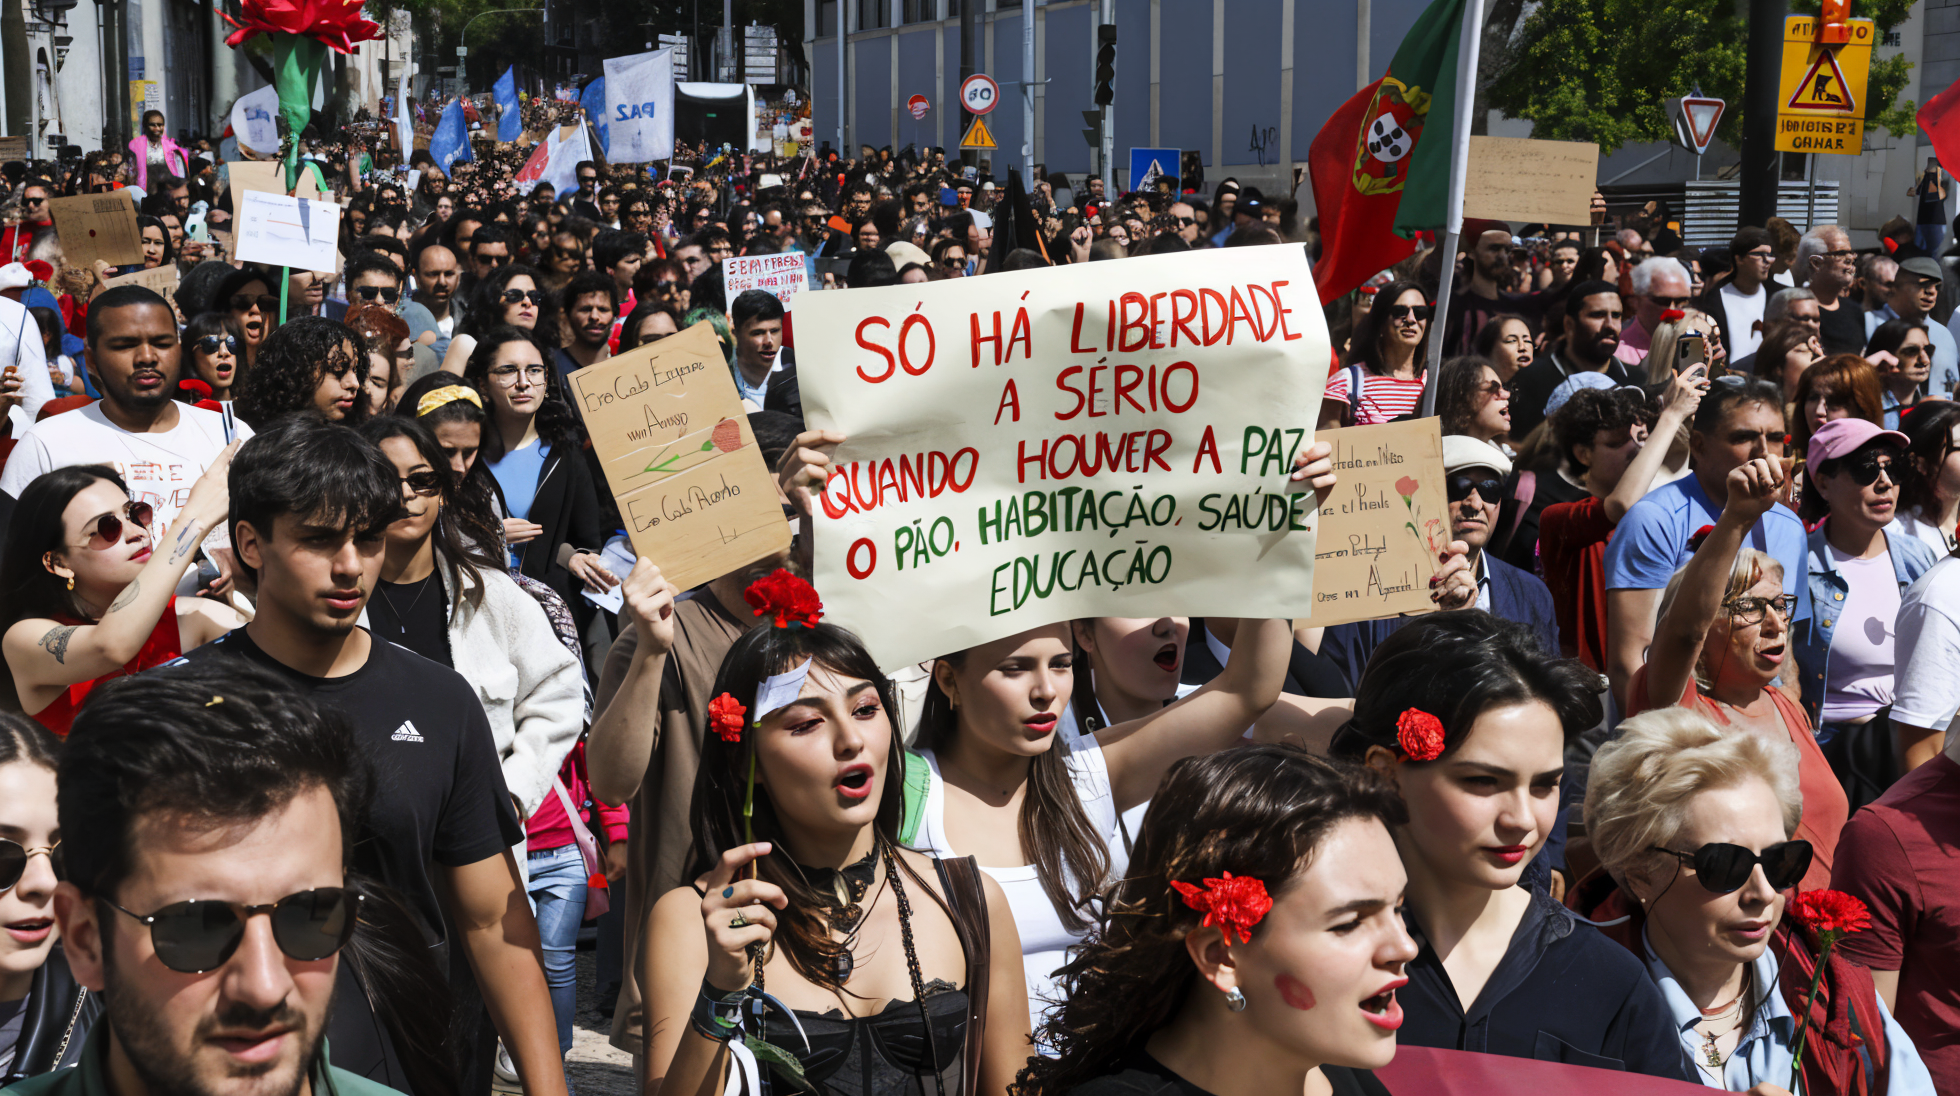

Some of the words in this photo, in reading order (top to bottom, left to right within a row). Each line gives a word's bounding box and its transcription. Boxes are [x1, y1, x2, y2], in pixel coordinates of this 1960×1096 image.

[854, 301, 936, 383] SÓ
[970, 290, 1032, 368] HÁ
[1070, 280, 1303, 354] LIBERDADE
[994, 378, 1021, 425] A
[1055, 356, 1200, 420] SÉRIO
[819, 446, 980, 520] QUANDO
[1018, 429, 1173, 484] HOUVER
[1193, 425, 1222, 474] A
[1241, 425, 1305, 477] PAZ
[846, 537, 877, 580] O
[990, 540, 1172, 617] EDUCAÇÃO
